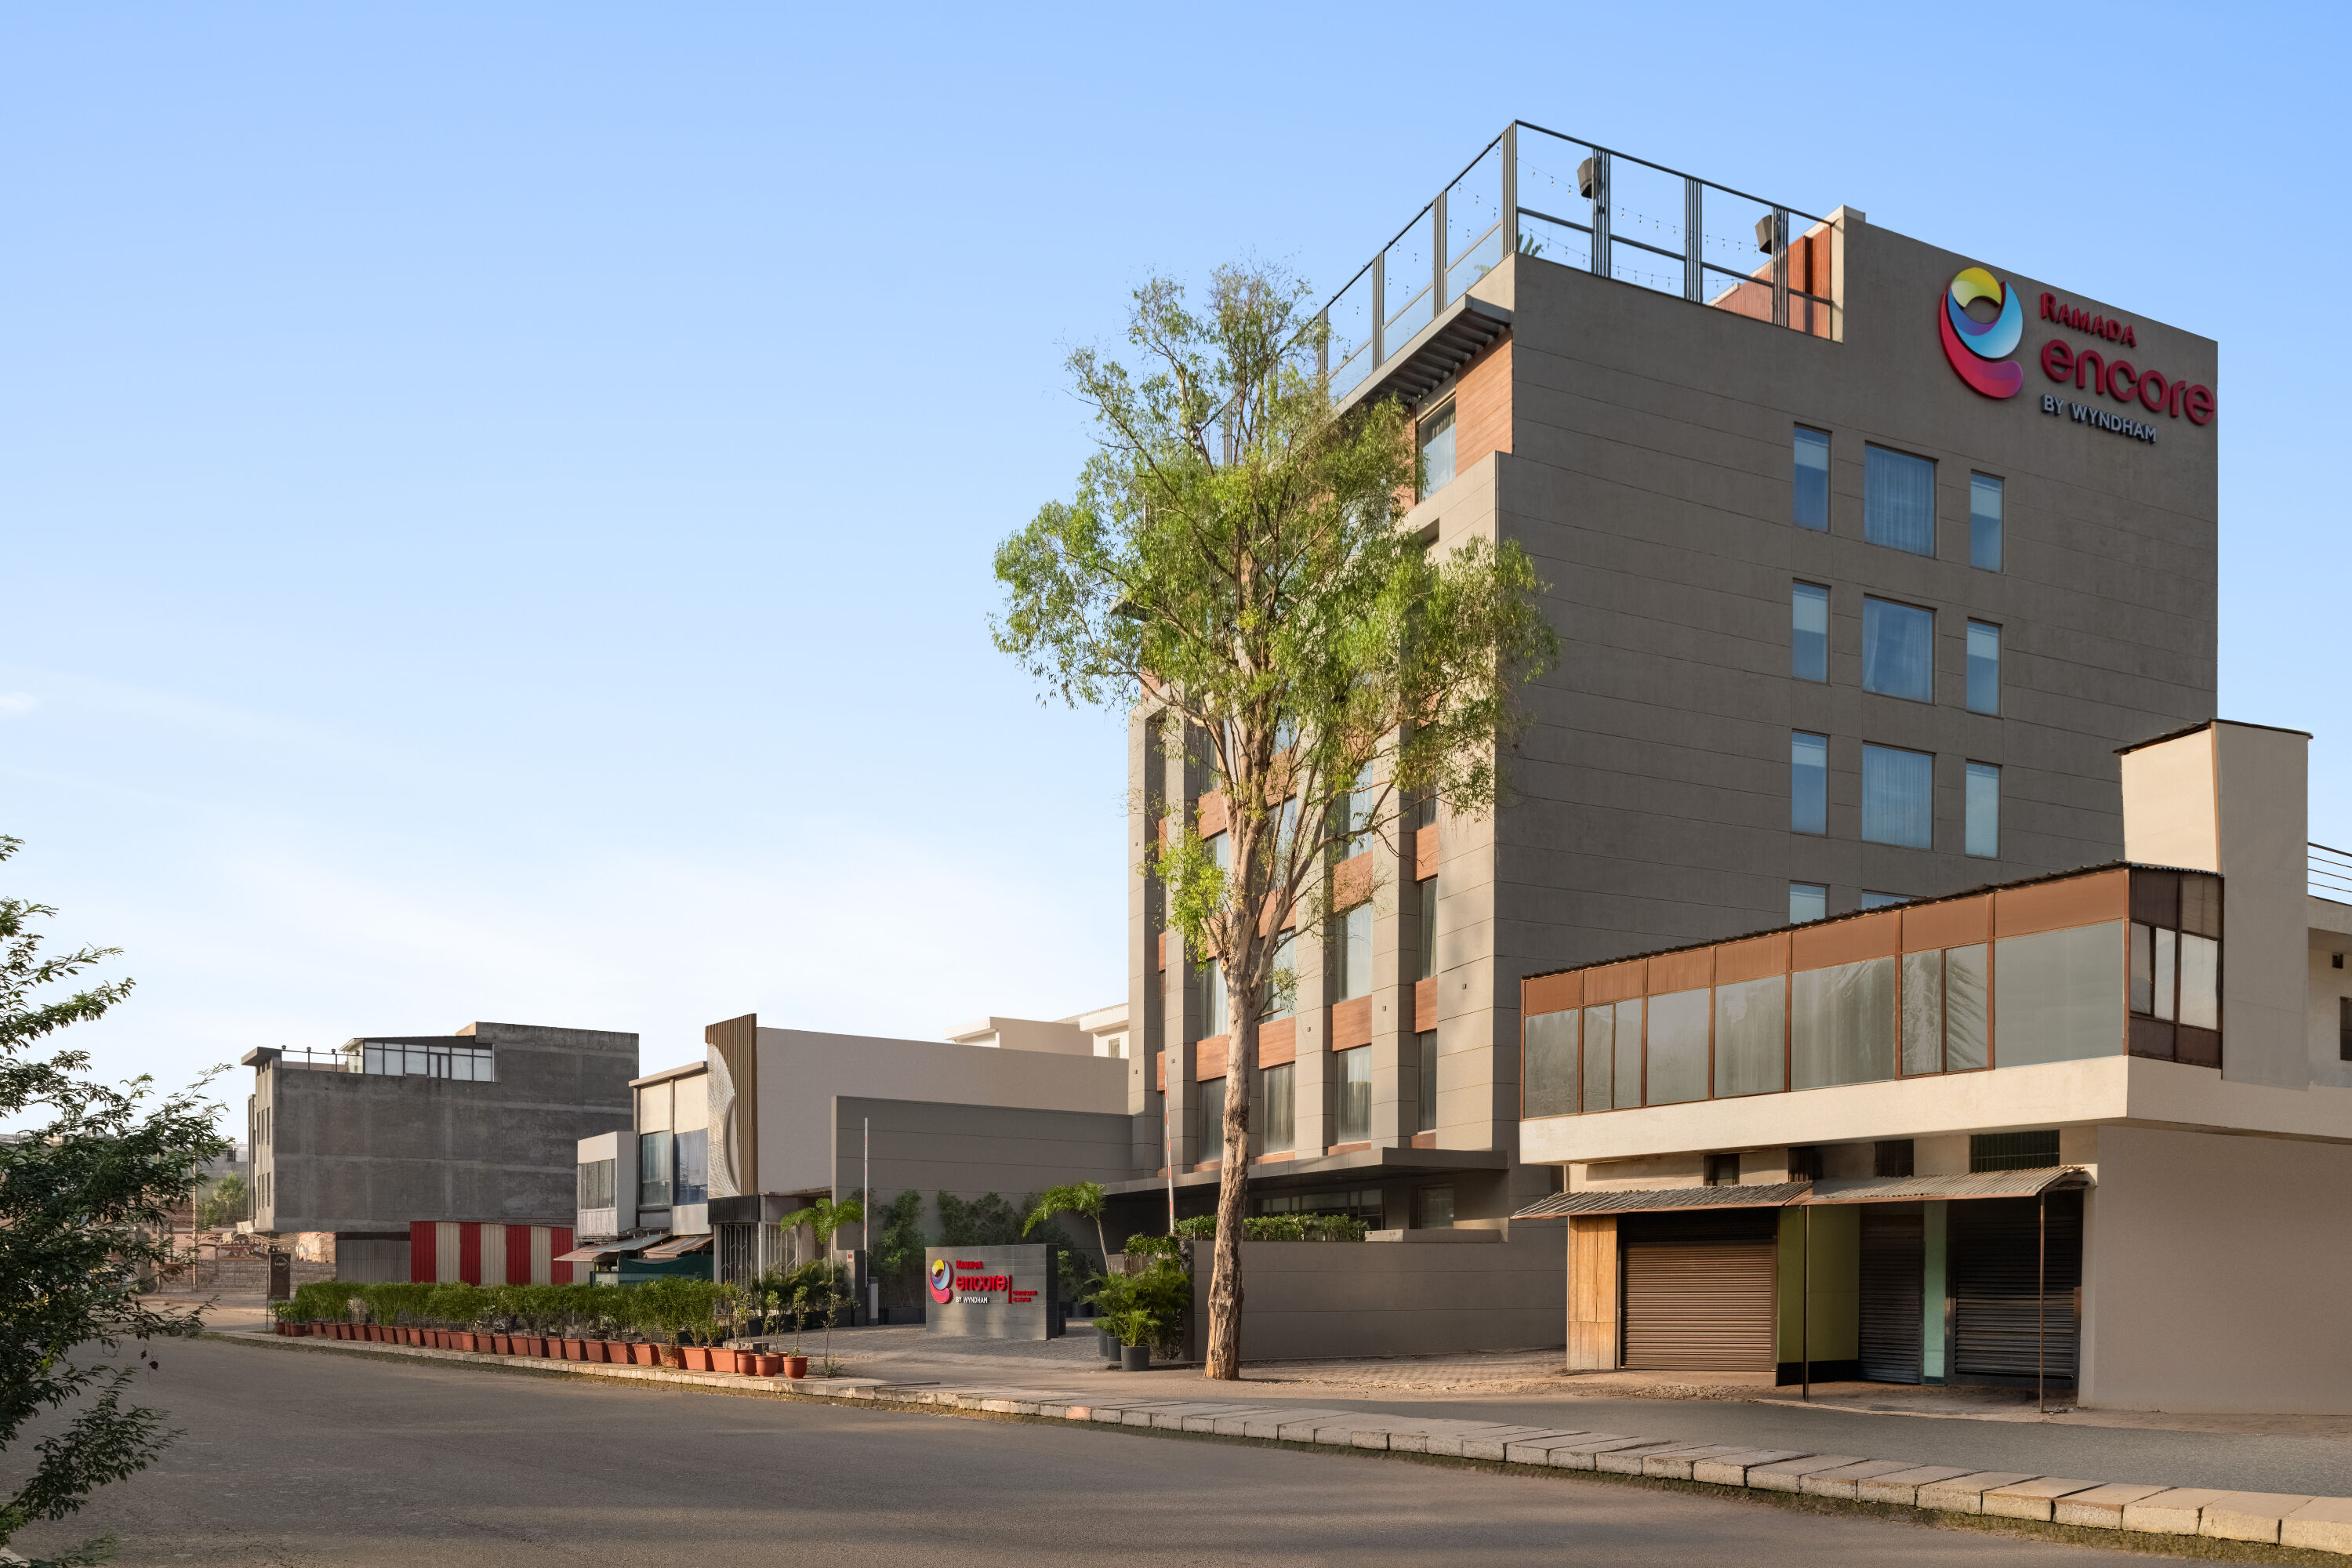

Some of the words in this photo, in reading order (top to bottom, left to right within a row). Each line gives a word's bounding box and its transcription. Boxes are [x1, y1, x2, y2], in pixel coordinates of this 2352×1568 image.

[2040, 292, 2136, 348] RAMADA
[2041, 339, 2215, 426] encore
[2042, 394, 2063, 416] BY
[2069, 402, 2156, 444] WYNDHAM
[956, 1275, 1007, 1291] encore
